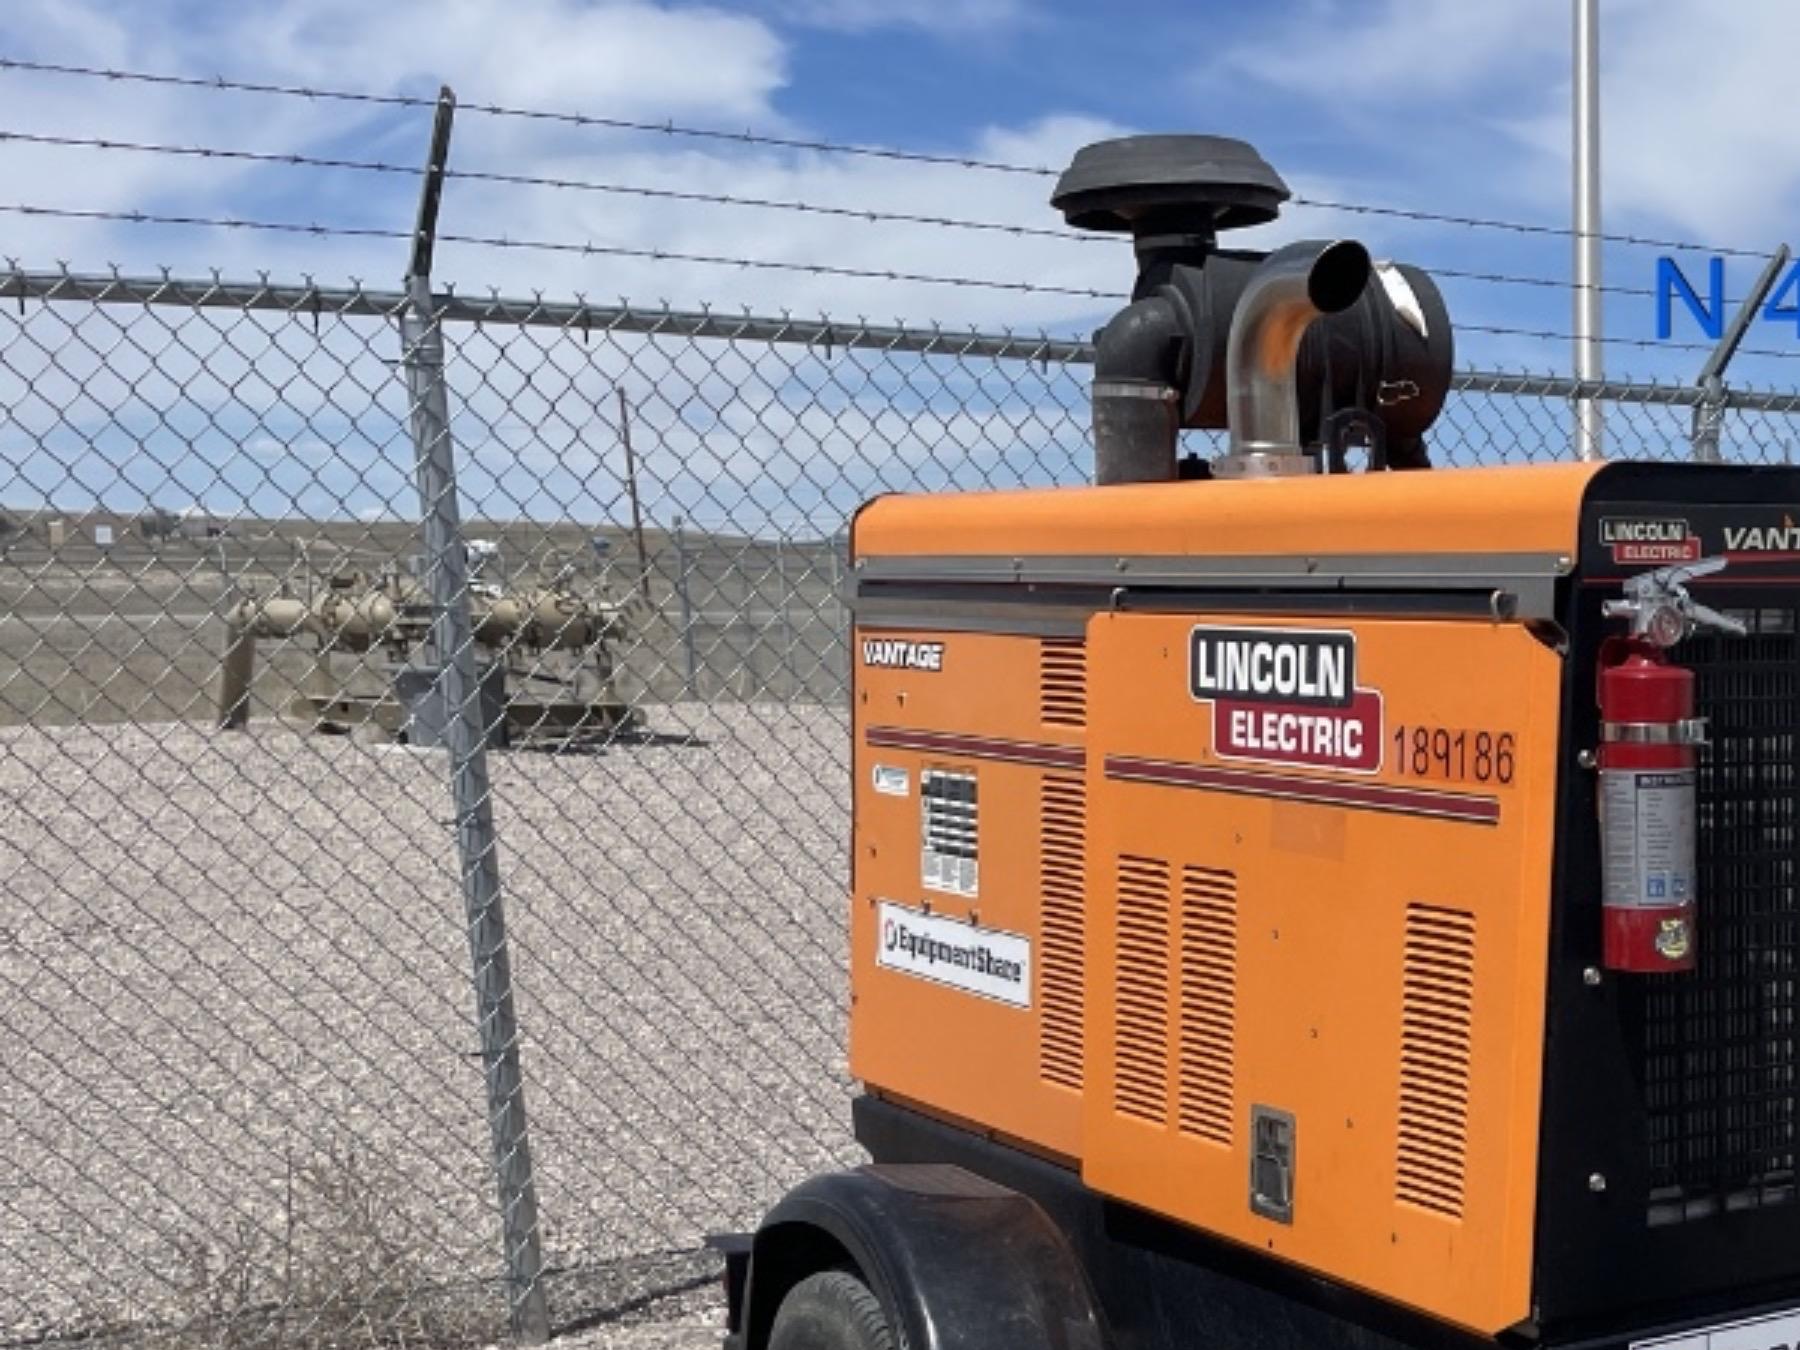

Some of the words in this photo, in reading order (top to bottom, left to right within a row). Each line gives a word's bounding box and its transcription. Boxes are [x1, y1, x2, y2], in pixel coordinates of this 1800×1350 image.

[1603, 521, 1685, 542] LINCOLN
[1624, 545, 1692, 559] ELECTRIC
[863, 640, 945, 670] VANTAGE
[1199, 638, 1346, 698] LINCOLN
[1230, 709, 1364, 758] ELECTRIC
[1393, 725, 1517, 784] 189186
